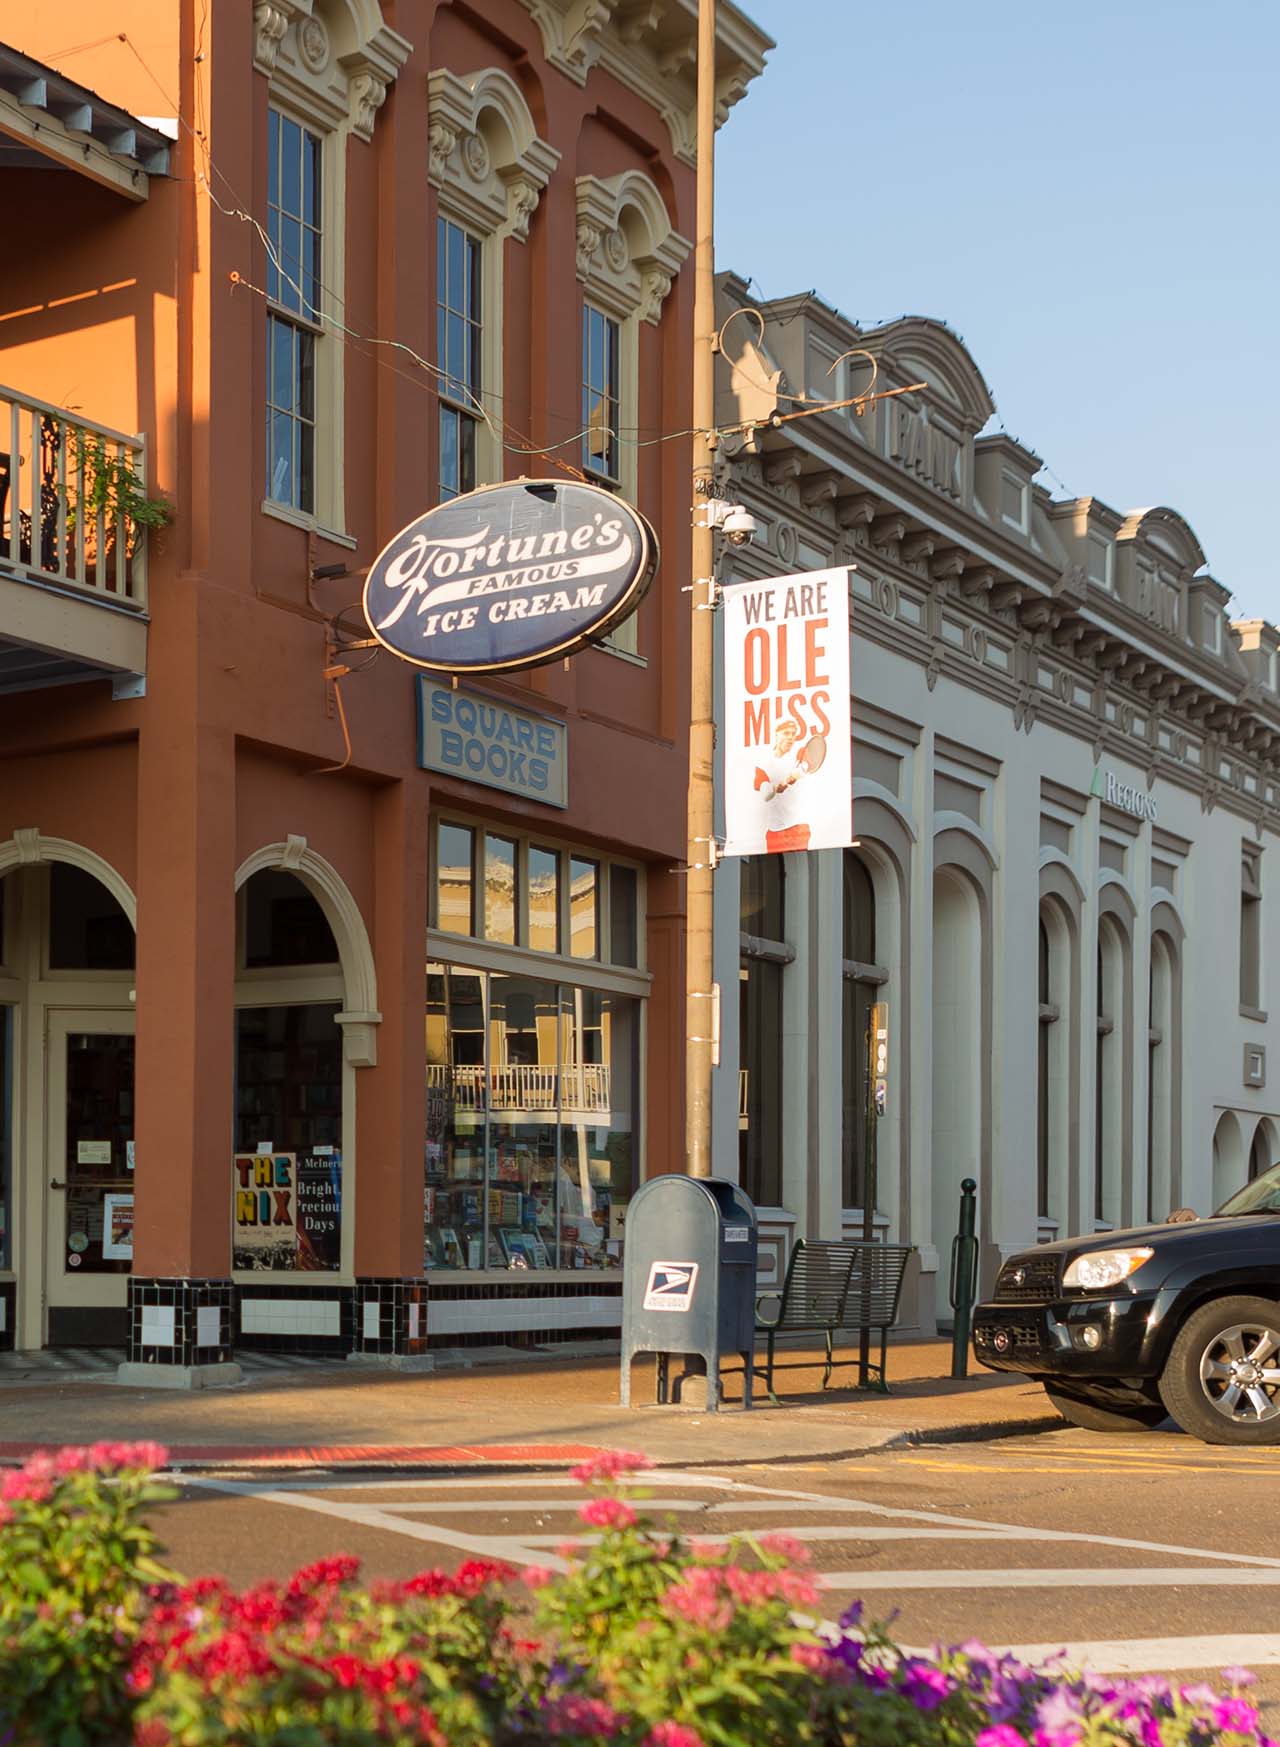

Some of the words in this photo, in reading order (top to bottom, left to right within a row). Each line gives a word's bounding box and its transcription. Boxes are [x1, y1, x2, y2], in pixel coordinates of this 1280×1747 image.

[890, 399, 961, 499] BANK
[377, 513, 626, 630] Fortune's
[466, 561, 580, 595] FAMOUS
[422, 606, 480, 637] ICE
[488, 583, 608, 624] CREAM
[743, 589, 776, 625] WE
[783, 582, 829, 619] ARE
[743, 618, 830, 696] OLE
[431, 690, 557, 760] SQUARE
[440, 730, 550, 791] BOOKS
[236, 1157, 293, 1188] THE
[236, 1191, 293, 1227] NIX
[305, 1216, 335, 1232] Days
